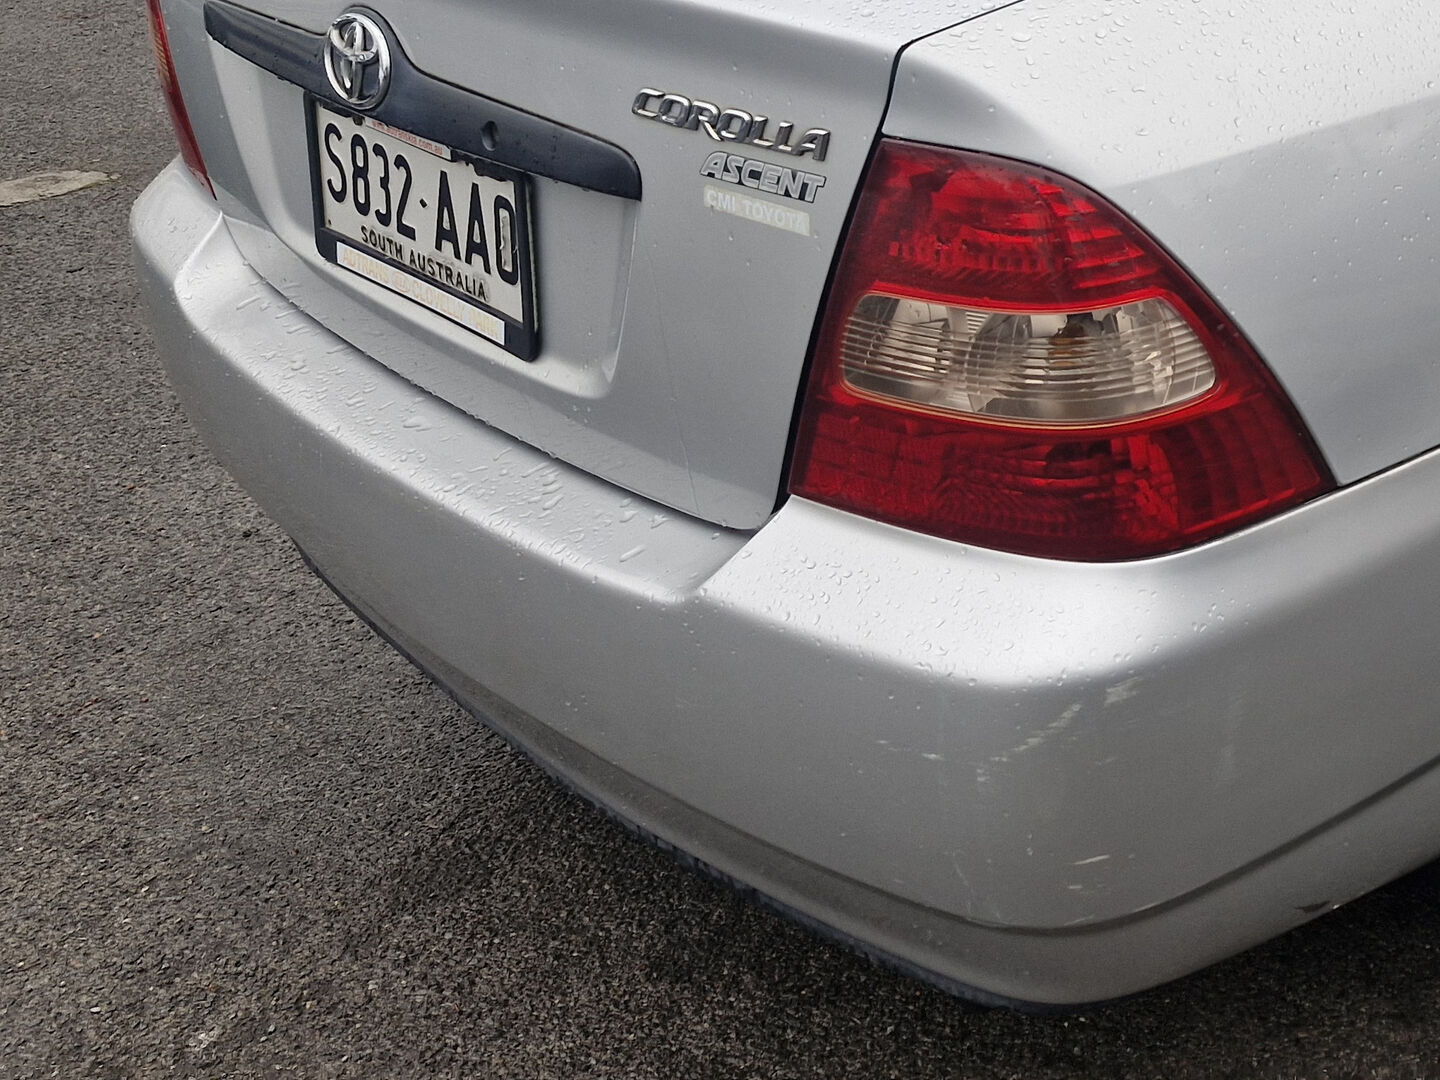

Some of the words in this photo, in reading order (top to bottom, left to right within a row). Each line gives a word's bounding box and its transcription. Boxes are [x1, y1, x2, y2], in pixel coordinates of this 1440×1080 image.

[632, 87, 831, 162] COROLLA
[700, 150, 827, 204] ASCENT
[706, 190, 736, 212] CMI
[742, 198, 808, 235] TOYOTA
[361, 225, 404, 260] SOUTH
[409, 249, 488, 302] AUSTRALIA
